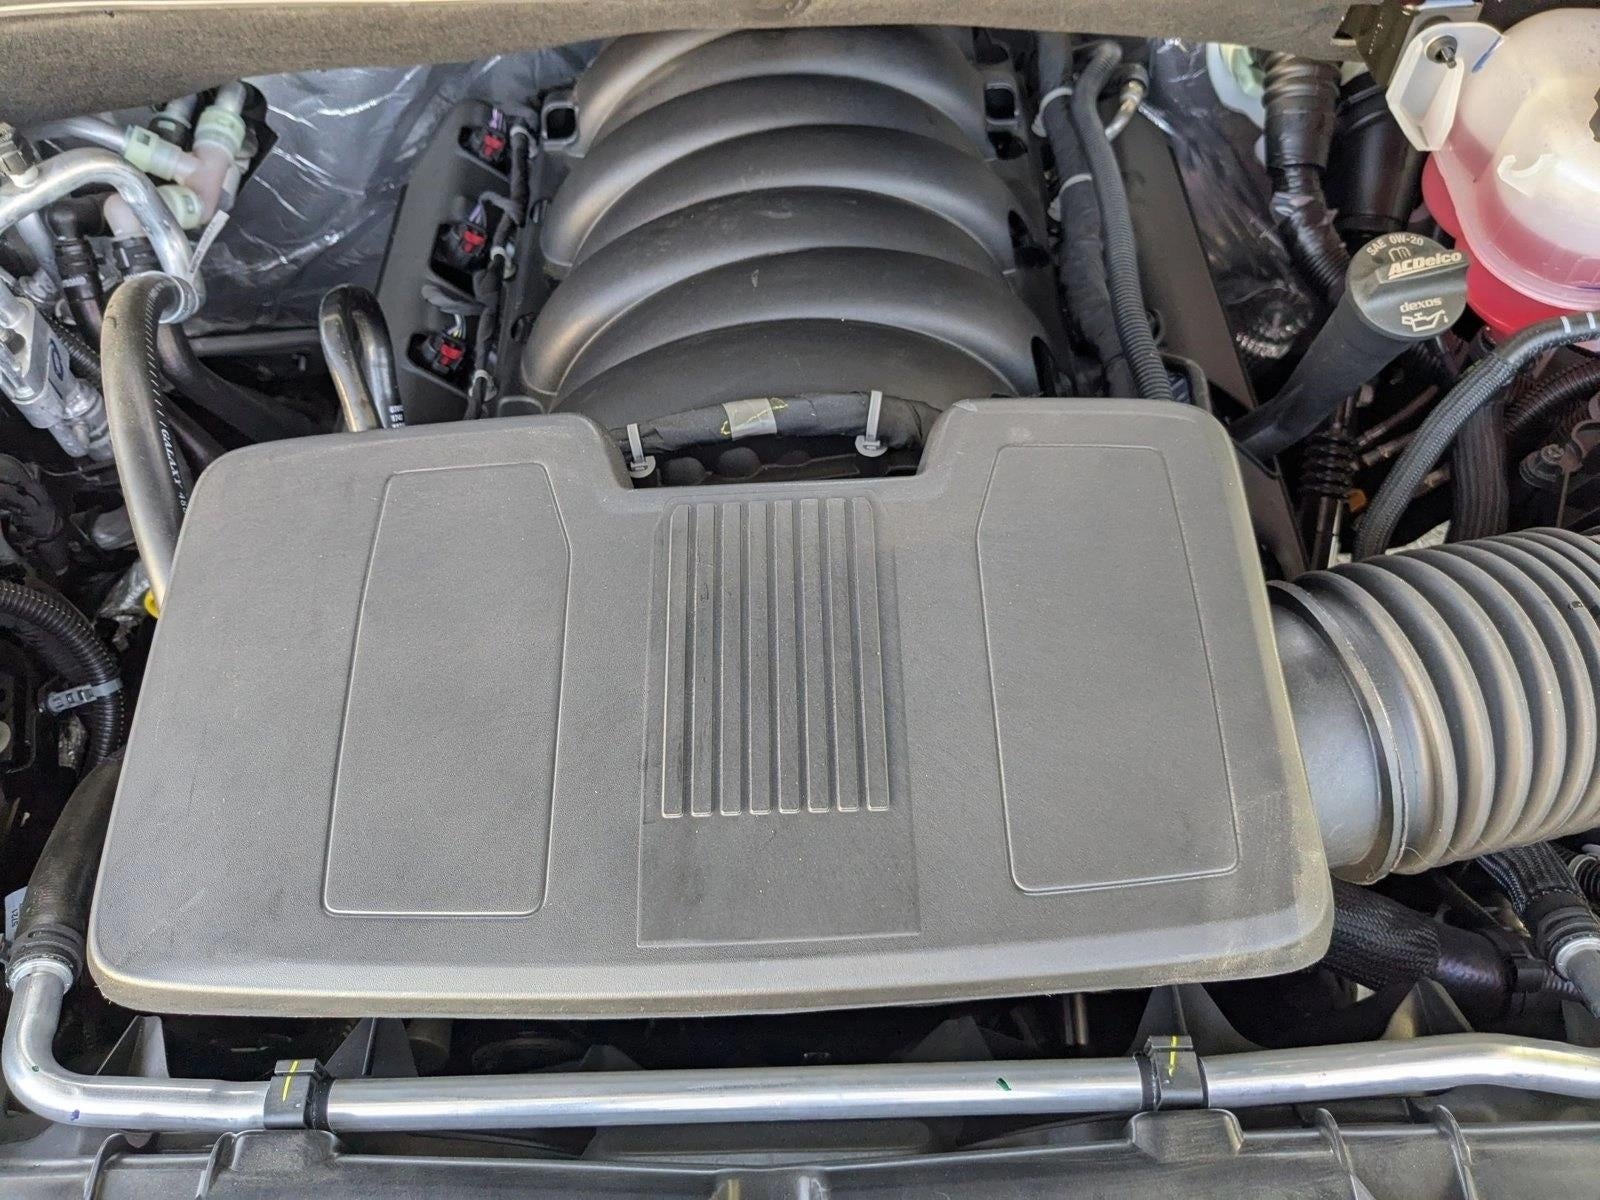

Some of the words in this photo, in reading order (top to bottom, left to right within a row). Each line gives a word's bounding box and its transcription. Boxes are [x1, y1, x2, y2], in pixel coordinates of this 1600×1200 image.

[1366, 239, 1387, 256] SAE
[1389, 233, 1424, 247] 0W-20
[1388, 252, 1462, 276] ACDelco
[1400, 297, 1442, 313] dexos
[161, 428, 183, 489] GALAXY
